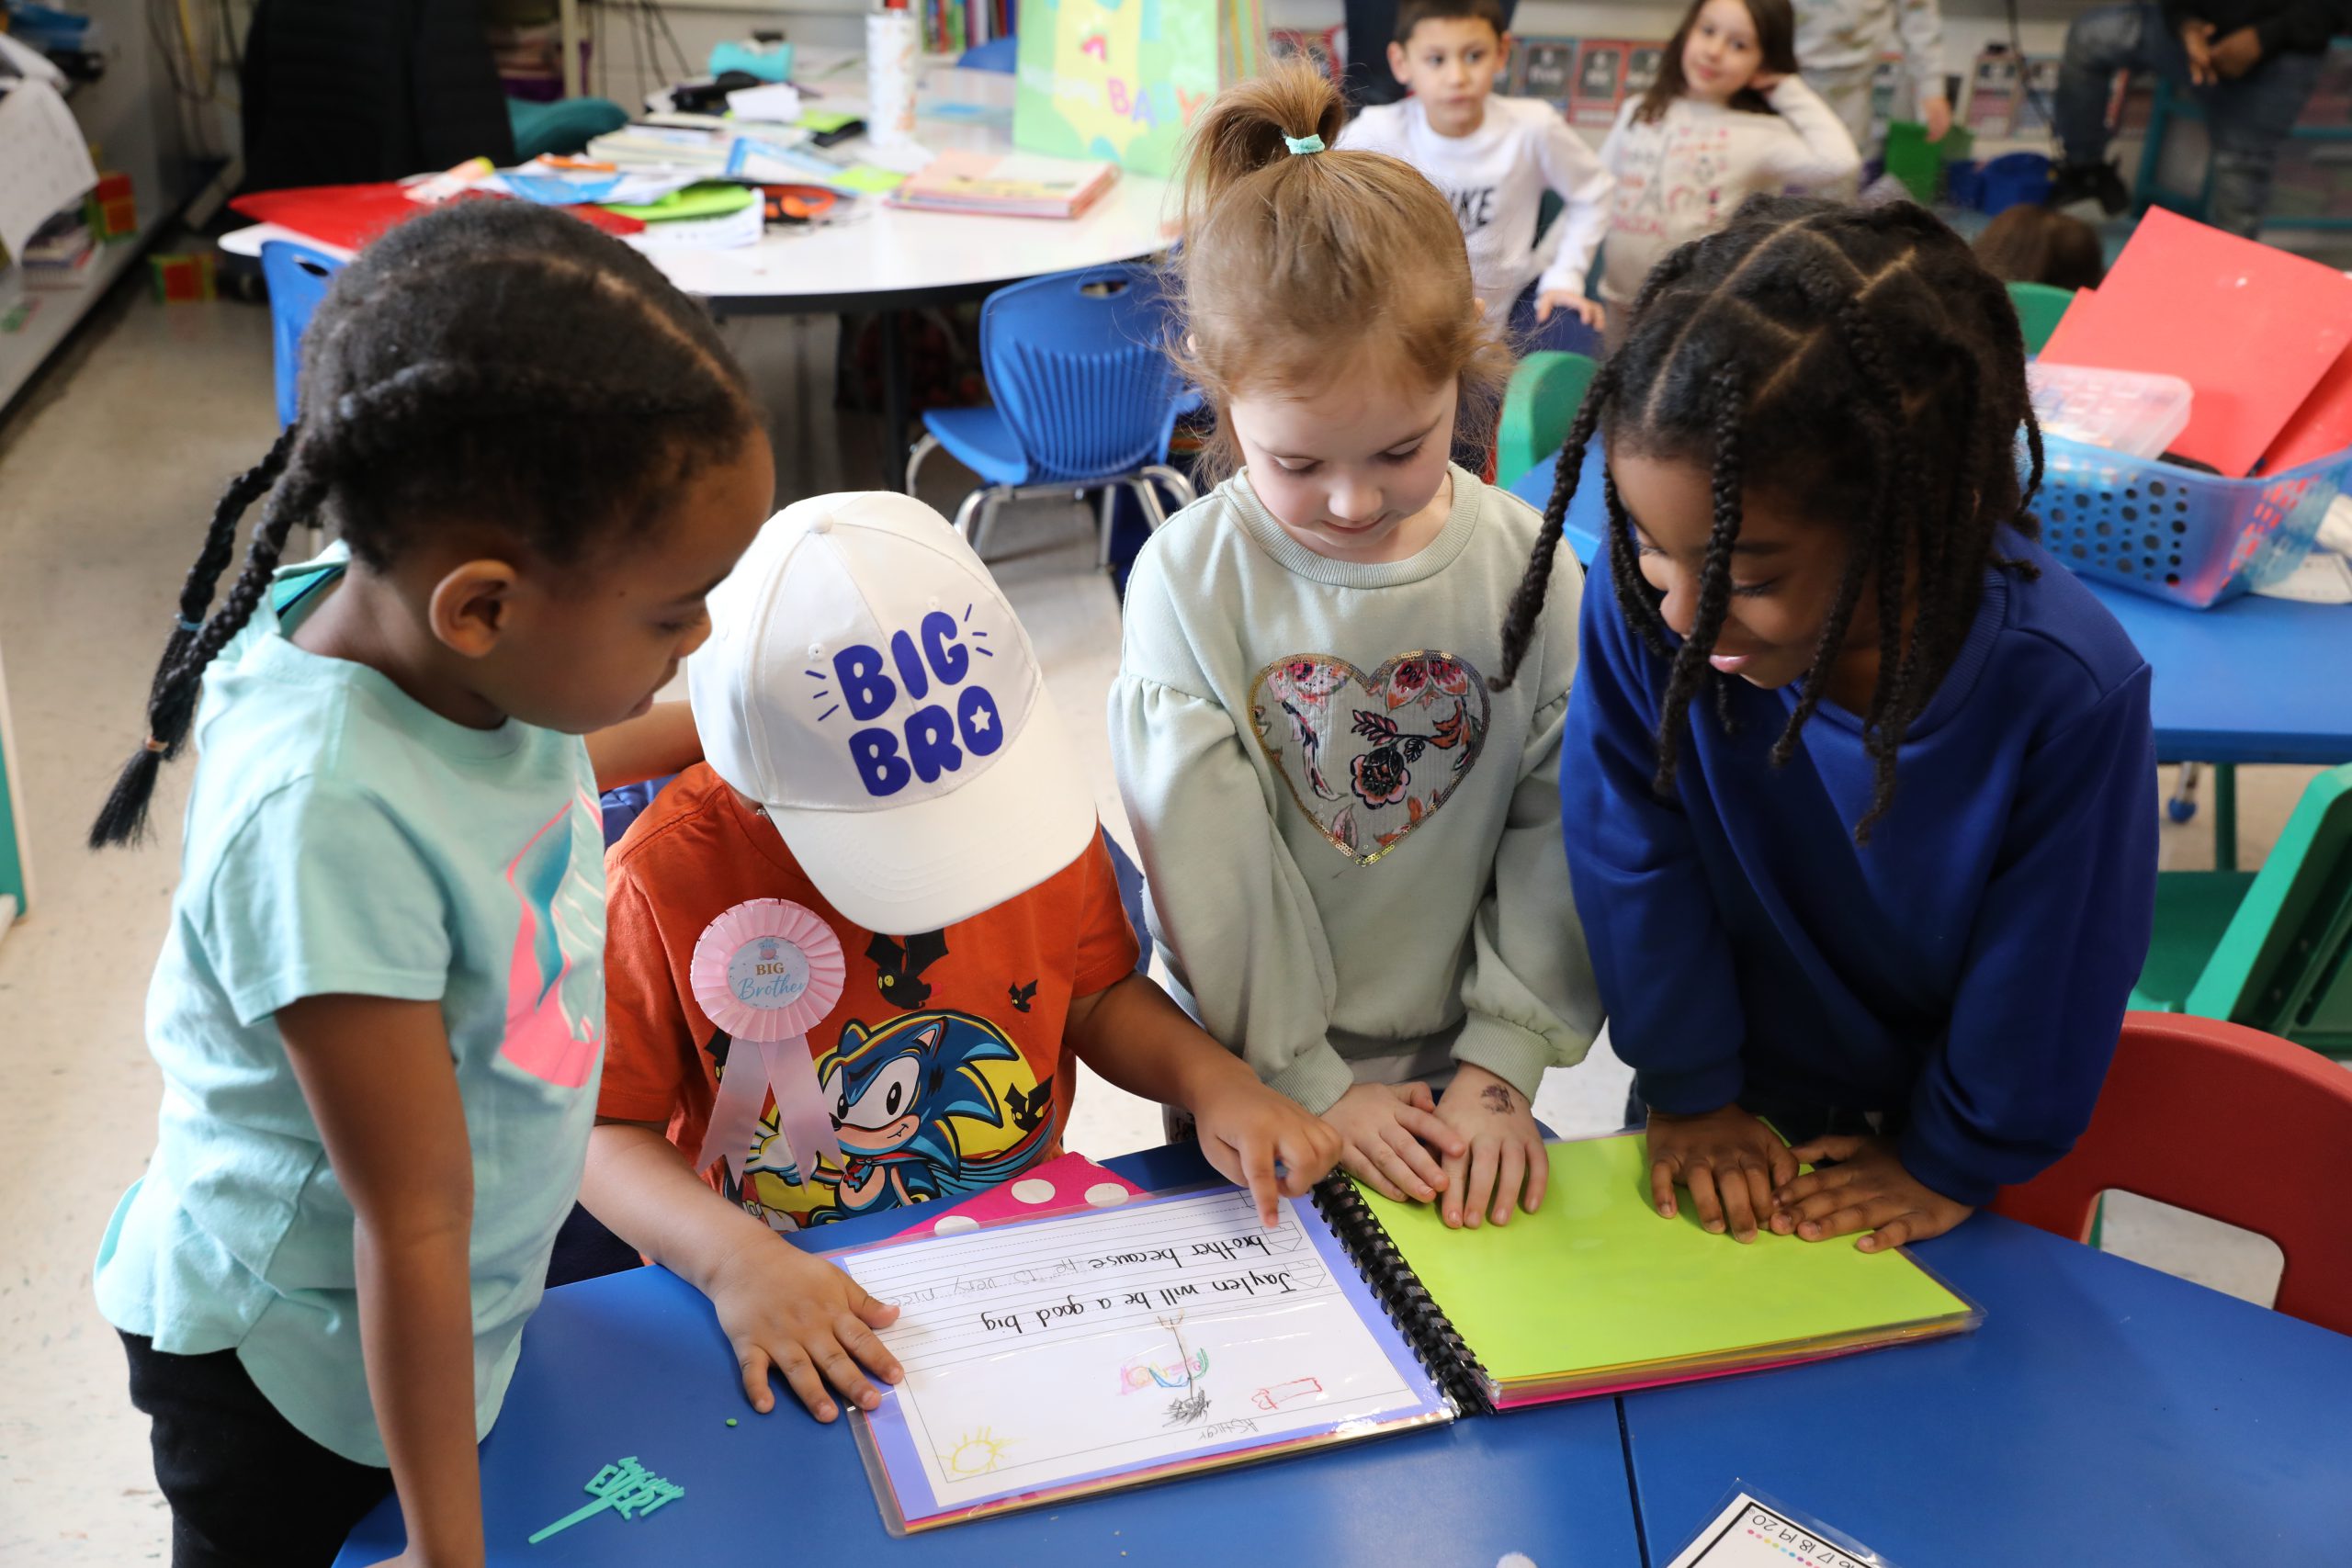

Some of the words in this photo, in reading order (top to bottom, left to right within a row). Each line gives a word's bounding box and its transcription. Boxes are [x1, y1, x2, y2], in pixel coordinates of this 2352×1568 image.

[1107, 77, 1205, 128] BABY
[1446, 186, 1495, 229] IKE
[832, 611, 969, 721] BIG
[848, 685, 1003, 797] BRO
[755, 962, 785, 976] BIG
[737, 974, 807, 1000] Brother
[1089, 1247, 1182, 1269] because
[1192, 1235, 1272, 1260] brother
[953, 1276, 998, 1294] very
[1211, 1269, 1297, 1296] Jaylen
[1096, 1298, 1113, 1309] a
[1125, 1292, 1152, 1310] be
[1160, 1283, 1199, 1307] will
[1035, 1295, 1085, 1327] good
[980, 1312, 1023, 1334] big
[1752, 1514, 1778, 1531] 20
[1778, 1528, 1798, 1544] 19
[1799, 1539, 1816, 1554] 18
[1815, 1551, 1836, 1564] 17
